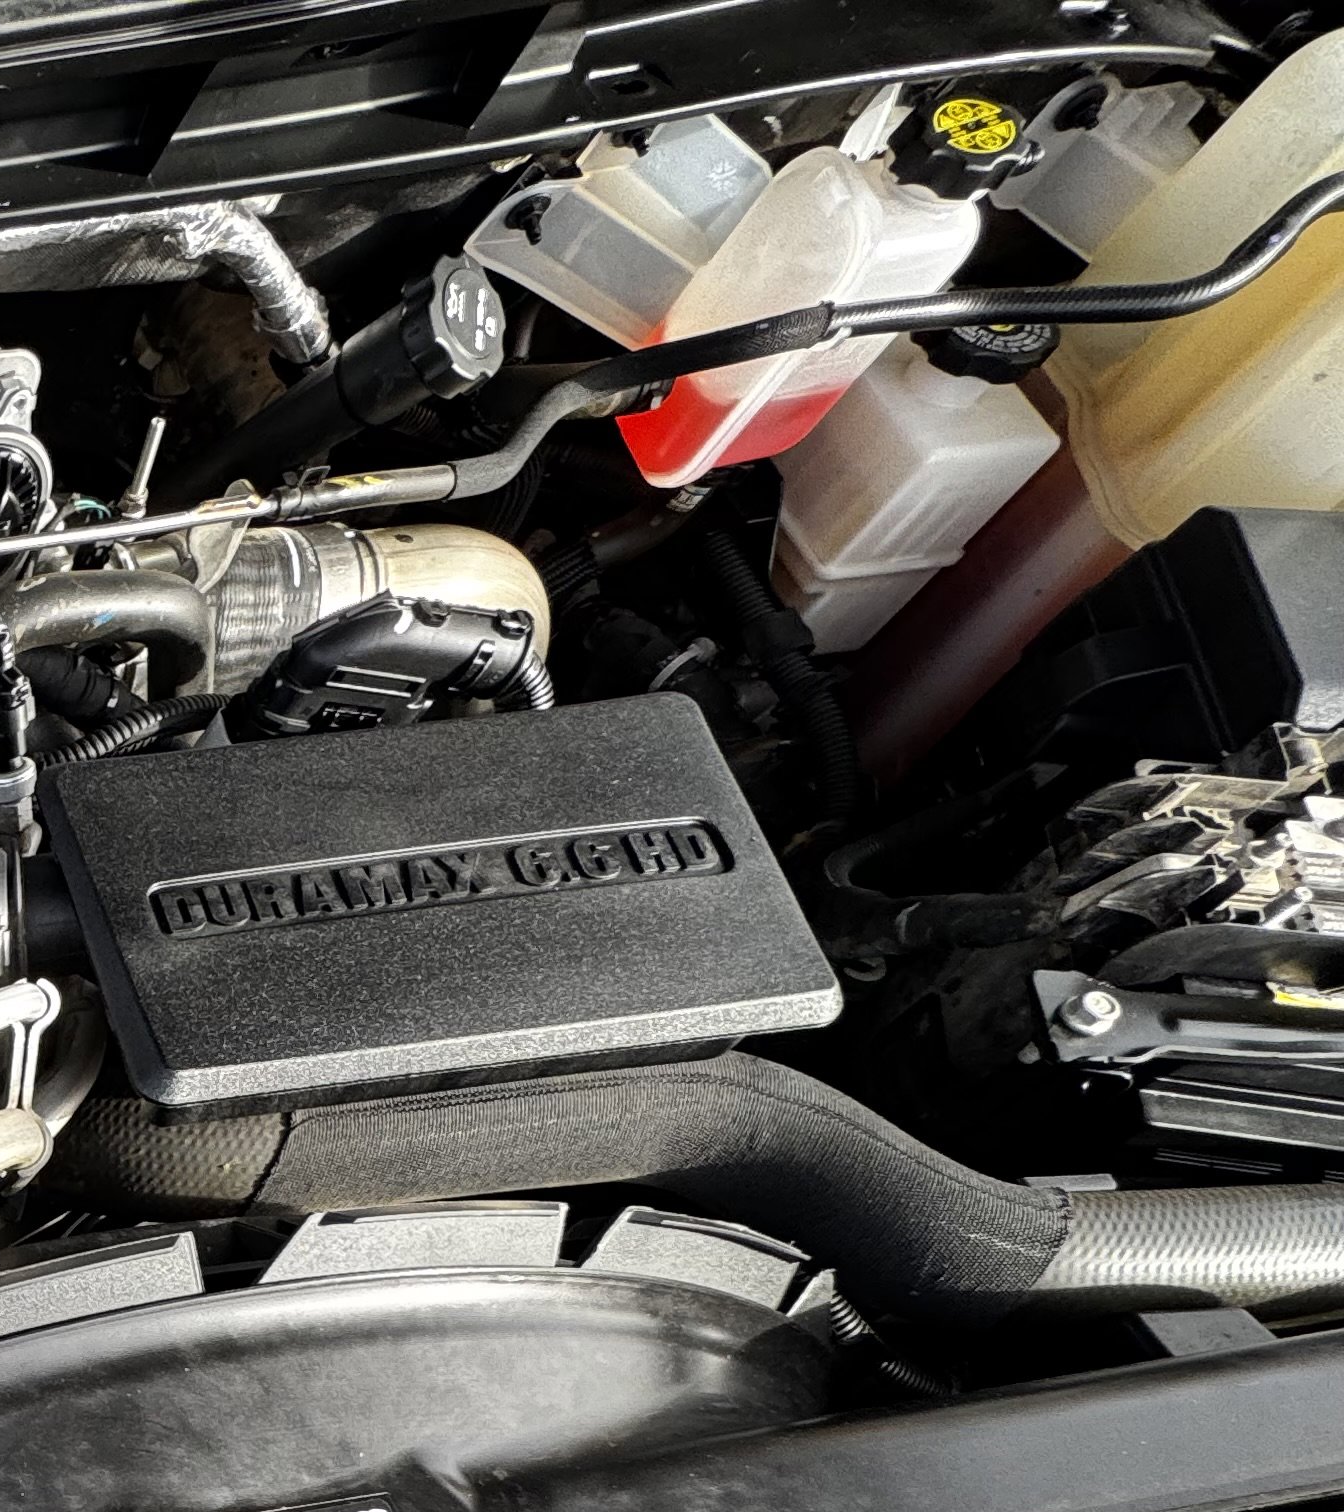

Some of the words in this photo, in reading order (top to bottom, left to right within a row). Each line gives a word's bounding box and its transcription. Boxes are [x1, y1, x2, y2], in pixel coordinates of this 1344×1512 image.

[154, 850, 498, 935] DURAMAX
[509, 836, 621, 888] 6.6
[624, 824, 721, 875] HD
